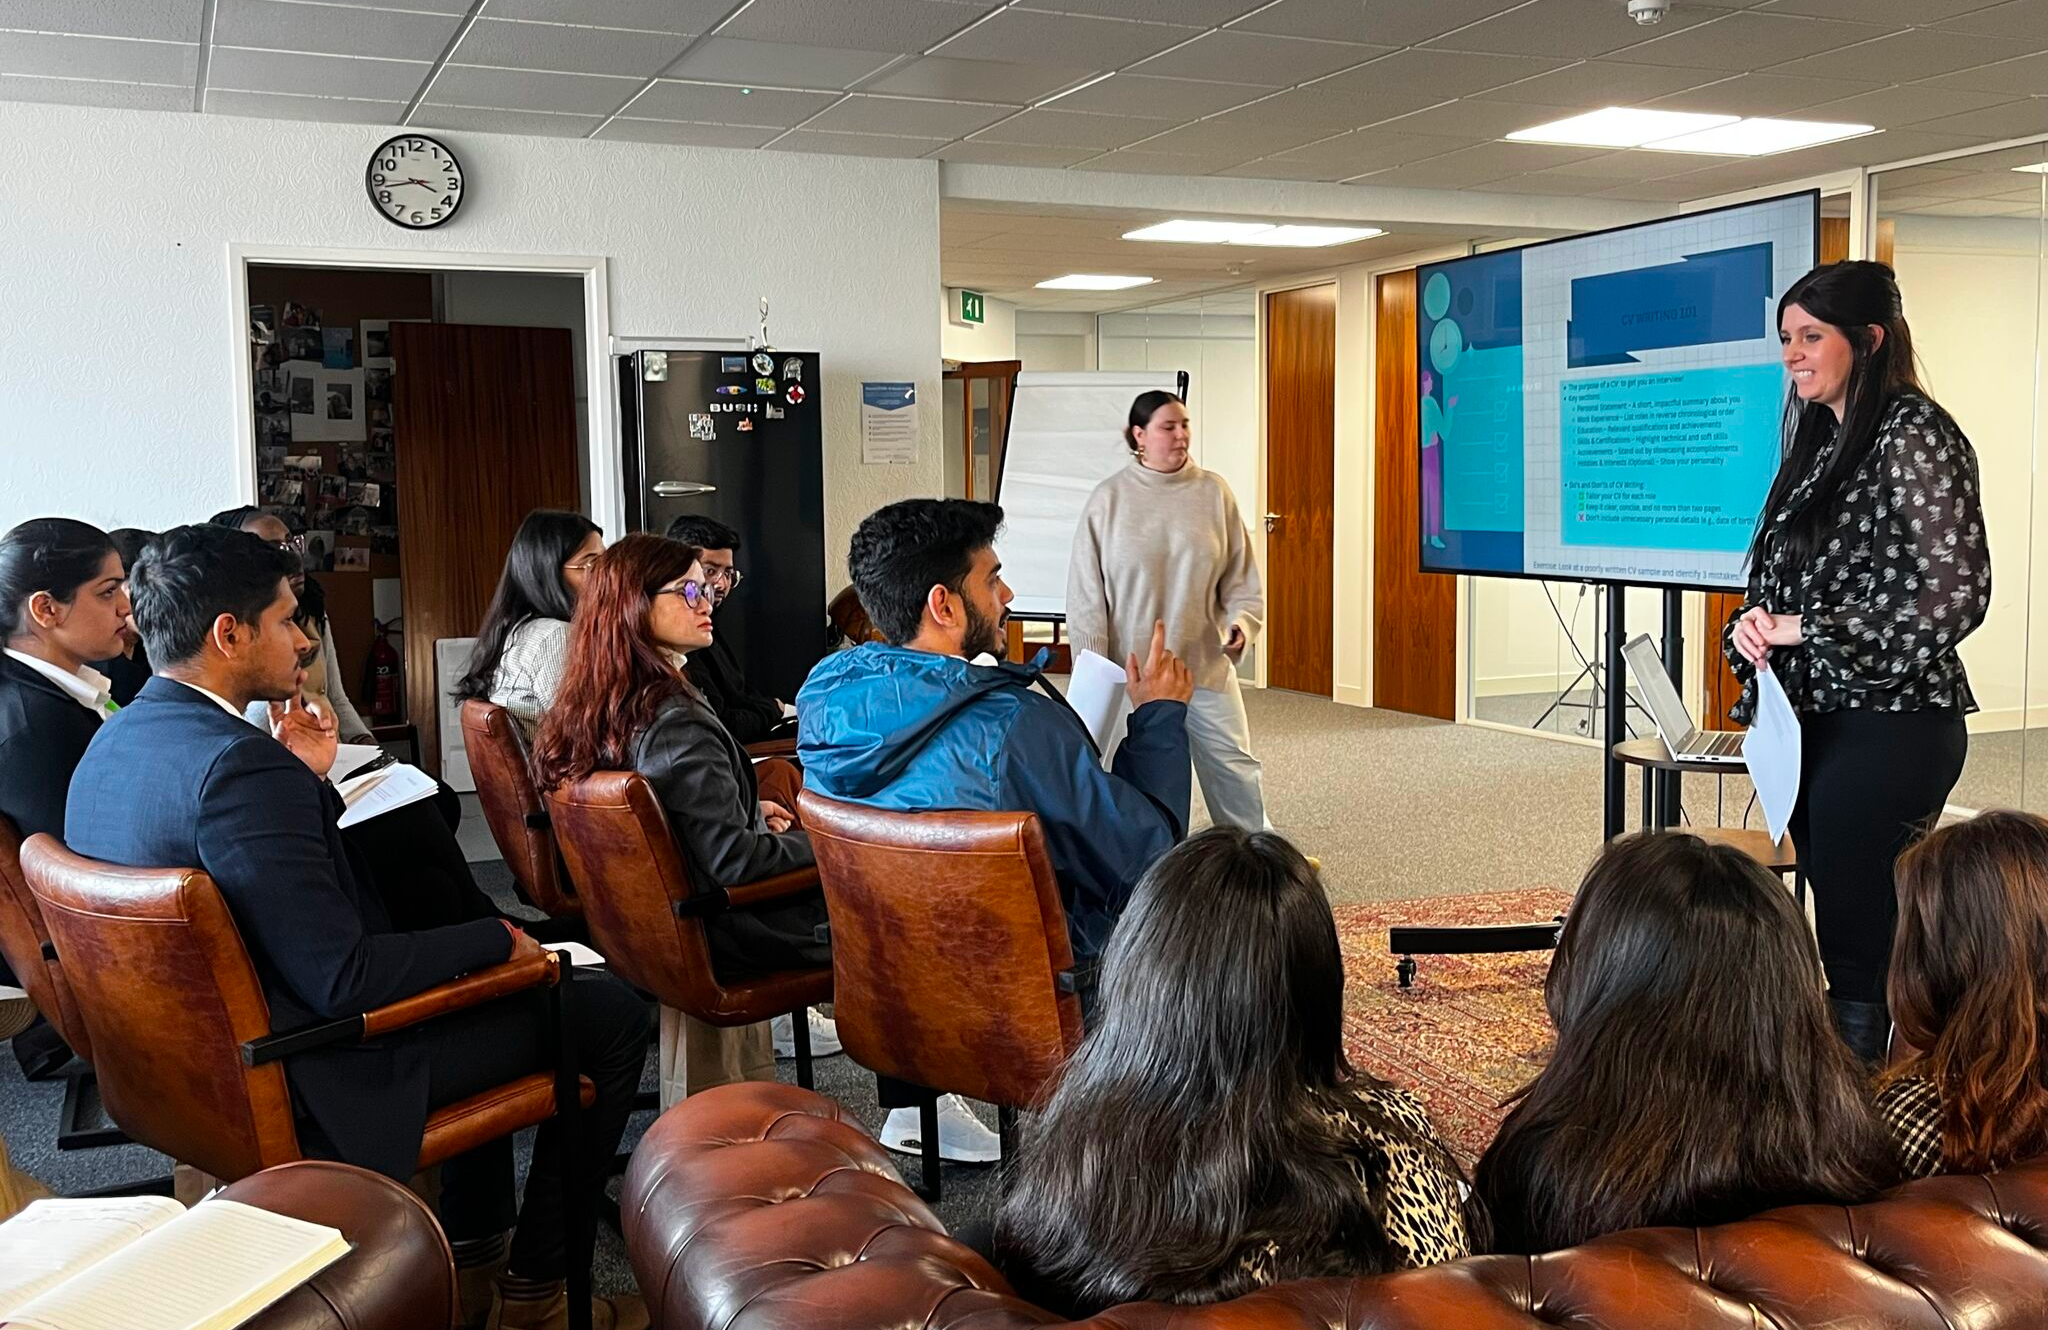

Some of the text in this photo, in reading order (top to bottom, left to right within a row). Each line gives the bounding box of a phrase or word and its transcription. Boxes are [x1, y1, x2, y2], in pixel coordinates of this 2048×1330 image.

[389, 145, 404, 157] 11
[406, 140, 425, 152] 12
[431, 147, 438, 159] 1
[378, 159, 395, 171] 10
[443, 160, 453, 172] 2
[373, 174, 385, 186] 9
[448, 178, 458, 190] 3
[379, 191, 391, 203] 8
[441, 196, 453, 208] 4
[395, 204, 405, 216] 7
[431, 208, 441, 219] 5
[411, 211, 423, 224] 6
[1622, 306, 1697, 326] CV WRITING 101
[1628, 380, 1636, 388] get
[1655, 399, 1681, 407] impactful
[1678, 410, 1717, 418] chronological
[1577, 426, 1602, 434] Education
[1632, 423, 1668, 431] qualifications
[1585, 565, 1603, 574] poorly
[1628, 566, 1636, 574] CV
[1676, 569, 1700, 580] identify
